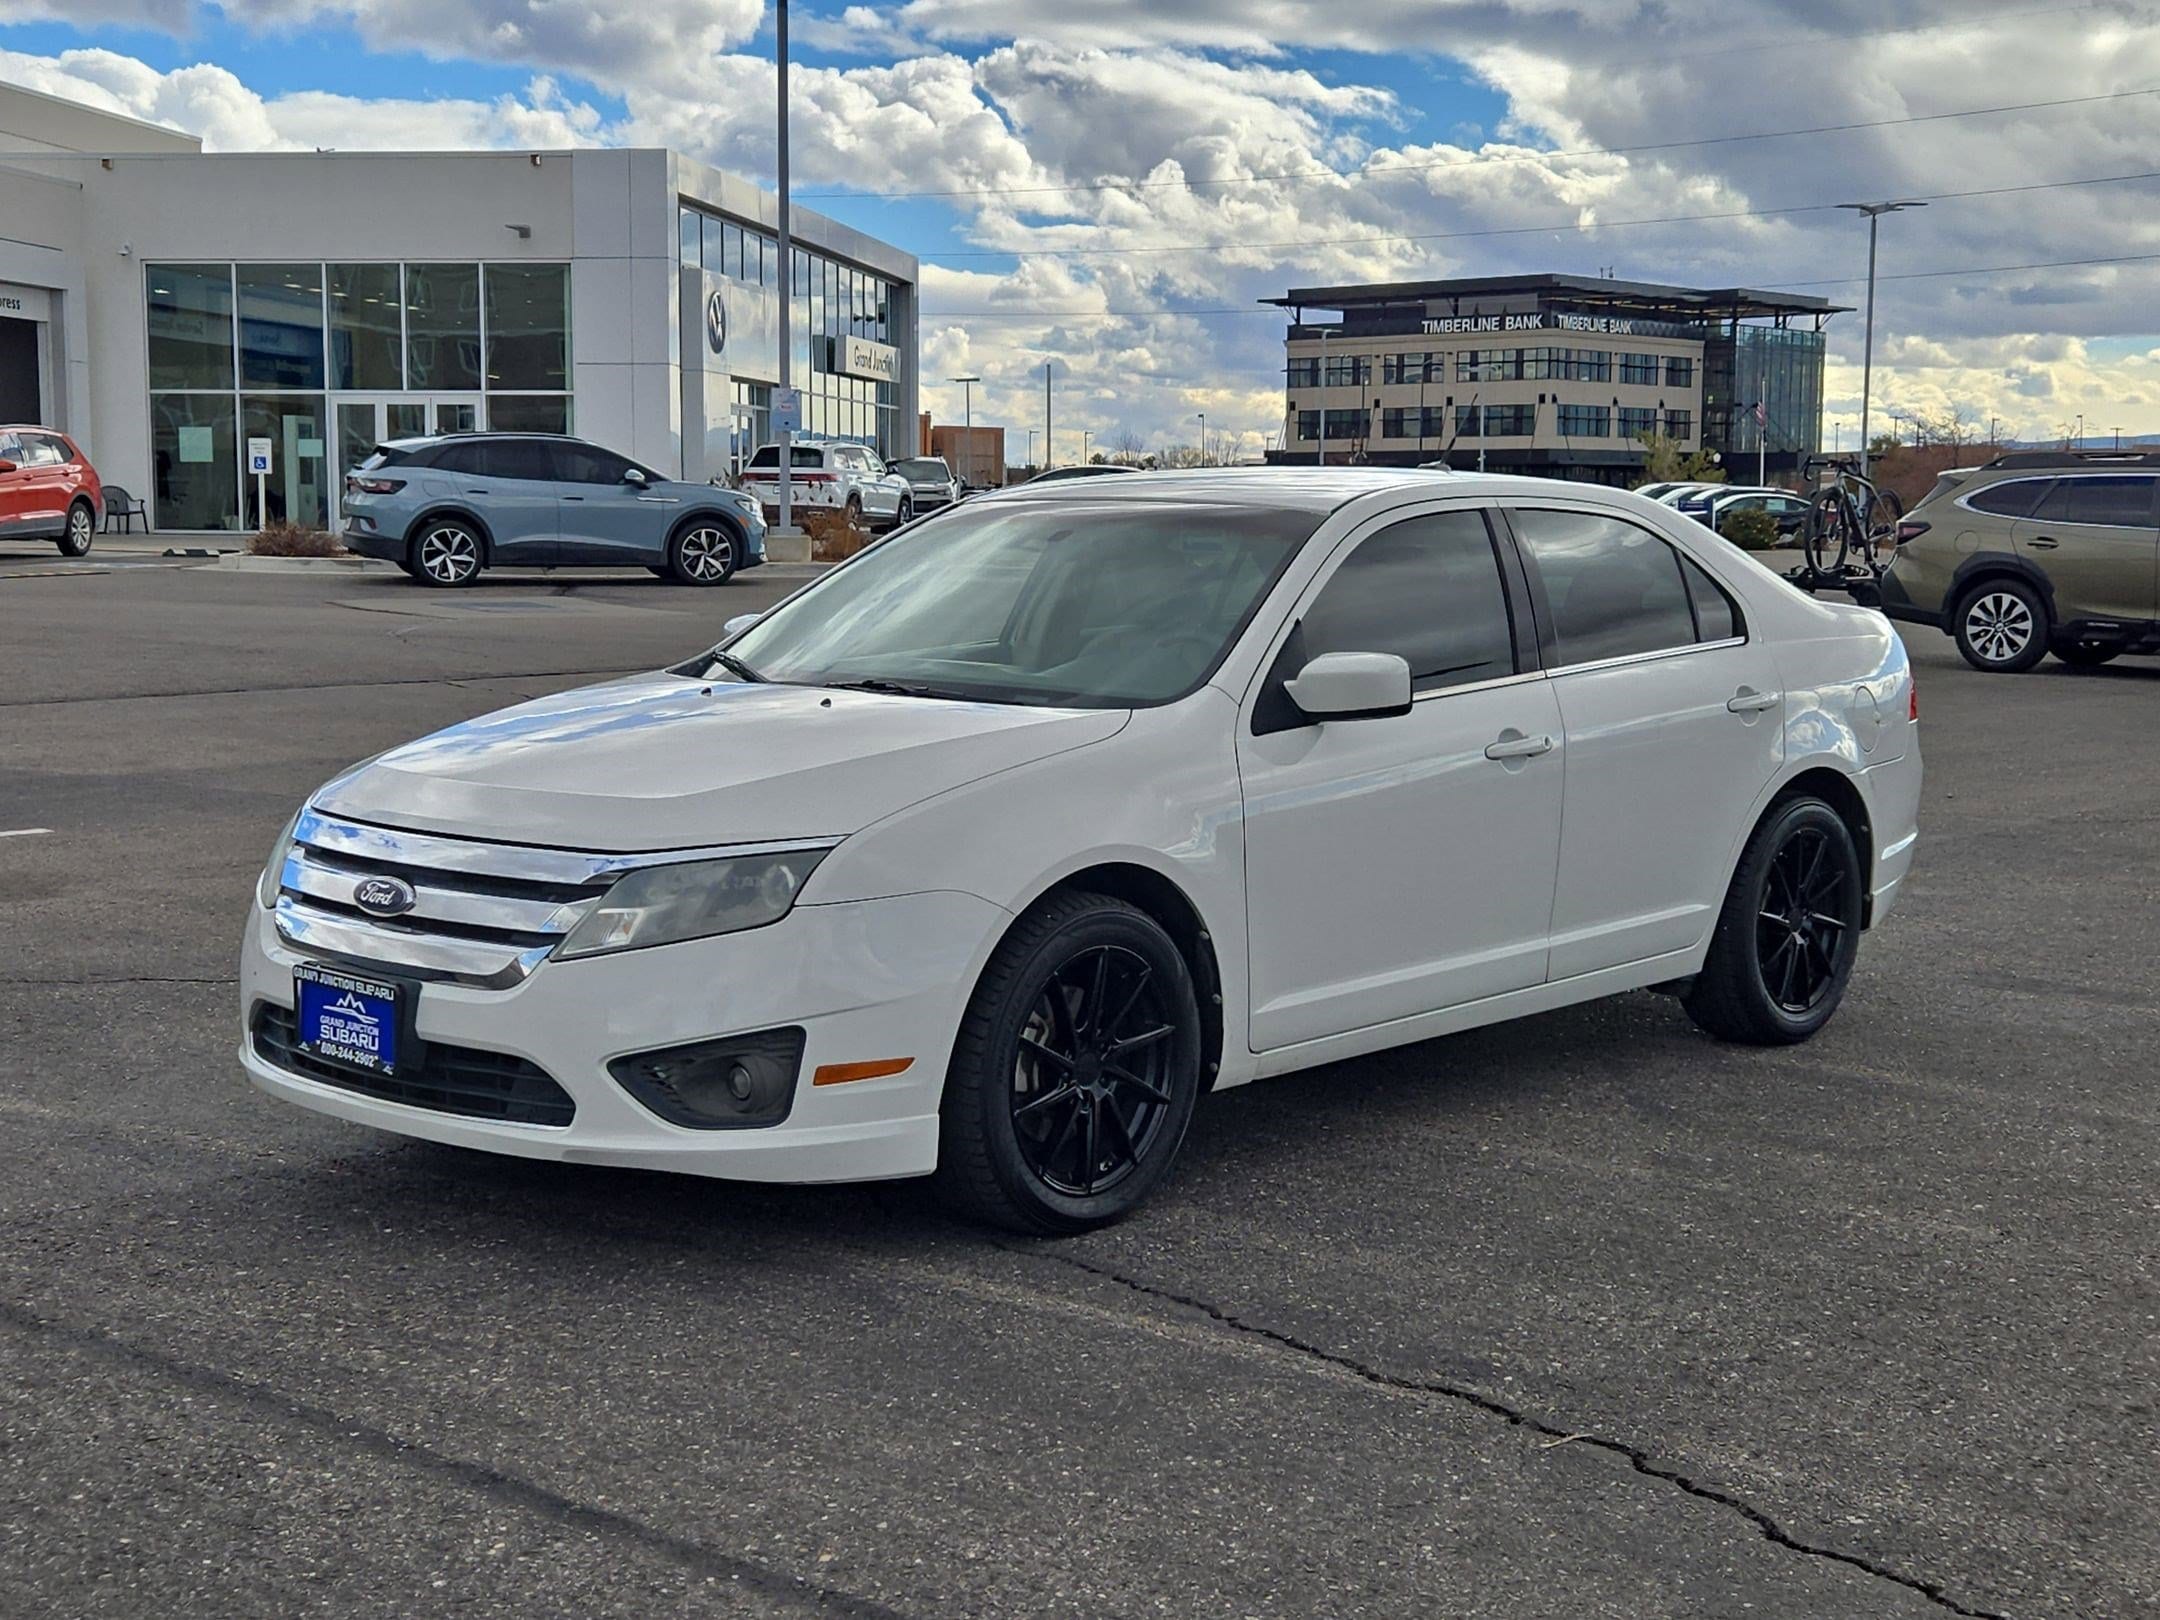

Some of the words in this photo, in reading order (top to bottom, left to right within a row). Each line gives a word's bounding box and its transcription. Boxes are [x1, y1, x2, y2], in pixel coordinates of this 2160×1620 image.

[1421, 316, 1500, 334] TIMBERLINE
[1505, 314, 1543, 330] BANK
[1557, 315, 1608, 333] TIMBERLINE
[1609, 319, 1633, 335] BANK
[854, 345, 872, 370] Grand
[359, 881, 396, 906] Ford
[319, 972, 355, 992] JUNCTION
[355, 981, 395, 1001] SUBARU
[319, 1015, 345, 1029] GRAND
[346, 1021, 380, 1036] JUNCTION
[319, 1025, 380, 1051] SUBARU
